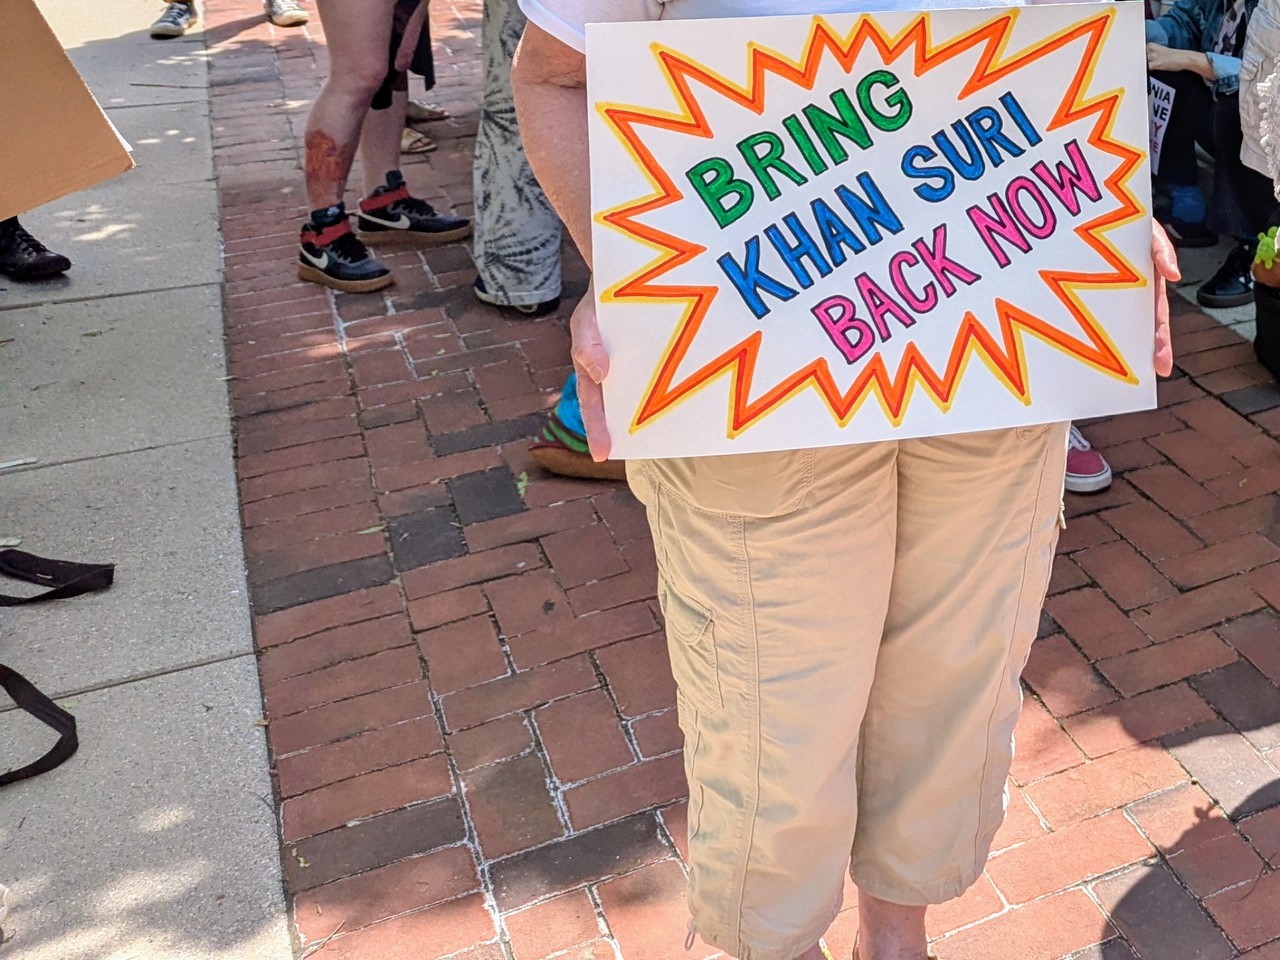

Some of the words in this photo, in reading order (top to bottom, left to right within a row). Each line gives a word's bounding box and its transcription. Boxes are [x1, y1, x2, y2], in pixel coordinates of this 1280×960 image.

[686, 70, 912, 229] BRING
[718, 171, 904, 320] KHAN
[901, 91, 1044, 203] SURI
[811, 223, 981, 365] BACK
[966, 139, 1103, 269] NOW
